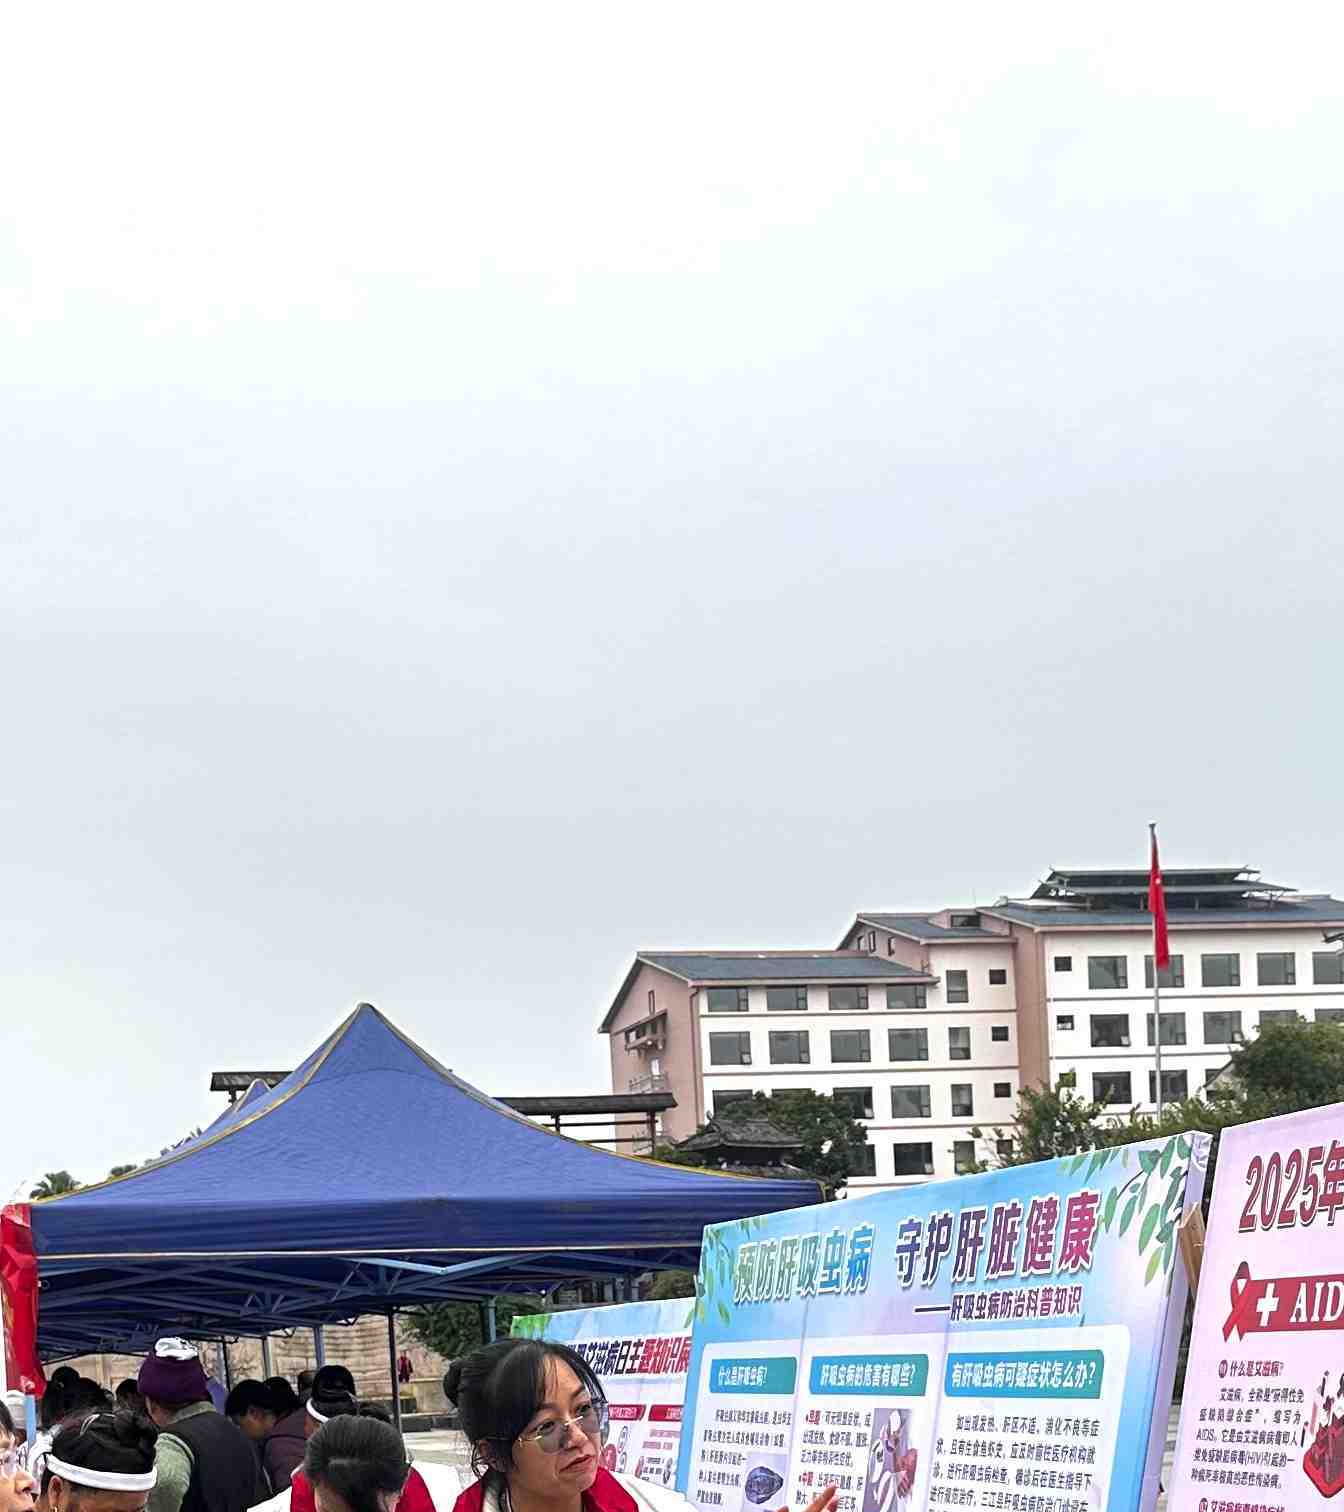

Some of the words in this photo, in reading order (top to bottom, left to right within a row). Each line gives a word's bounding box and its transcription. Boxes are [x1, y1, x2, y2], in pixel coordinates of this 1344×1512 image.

[733, 1222, 876, 1305] 预防肝吸虫病
[893, 1190, 1101, 1290] 守护肝脏健康
[952, 1360, 1096, 1388] 有肝吸虫病可疑症状怎么办?
